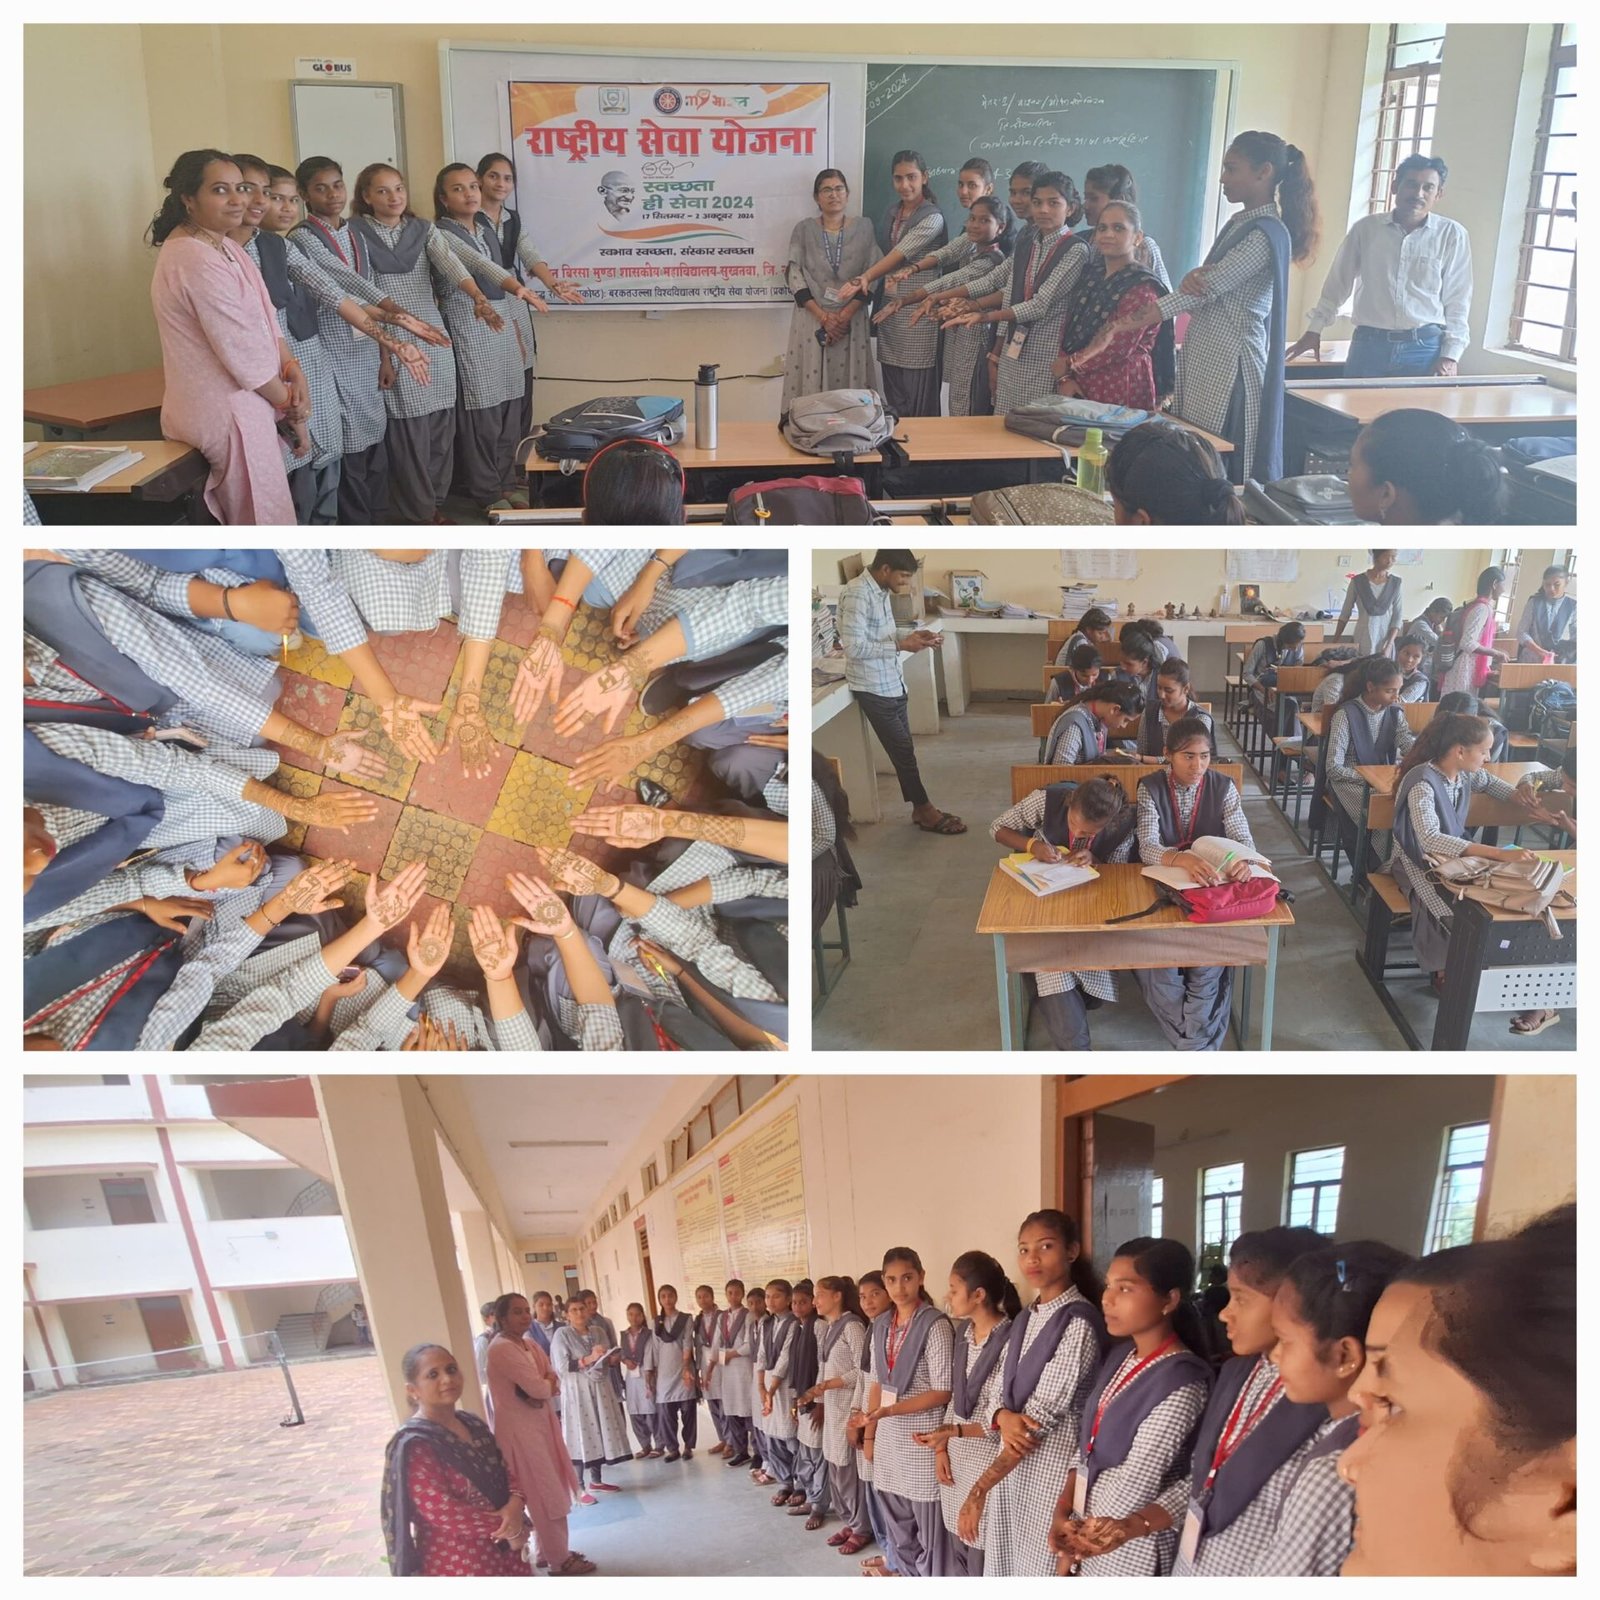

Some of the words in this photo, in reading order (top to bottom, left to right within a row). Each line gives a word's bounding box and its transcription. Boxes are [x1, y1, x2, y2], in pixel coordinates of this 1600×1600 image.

[313, 63, 352, 73] GLOBUS
[525, 119, 629, 163] राष्ट्रीय
[637, 119, 703, 157] सेवा
[710, 119, 817, 156] योजना
[642, 180, 715, 193] स्वच्छता
[641, 194, 664, 211] ही
[669, 194, 708, 209] सेवा
[711, 196, 754, 209] 2024
[599, 247, 633, 256] स्वभाव
[680, 245, 715, 256] संस्कार
[717, 247, 755, 255] स्वच्छता
[562, 263, 590, 279] बिरसा
[592, 267, 616, 283] मुण्डा
[619, 262, 660, 279] शासकीय
[608, 288, 652, 298] बरकतउल्ला
[654, 286, 700, 298] विश्वविद्यालय
[703, 285, 726, 298] राष्ट्रीय
[728, 286, 743, 297] सेवा
[745, 286, 768, 296] योजना
